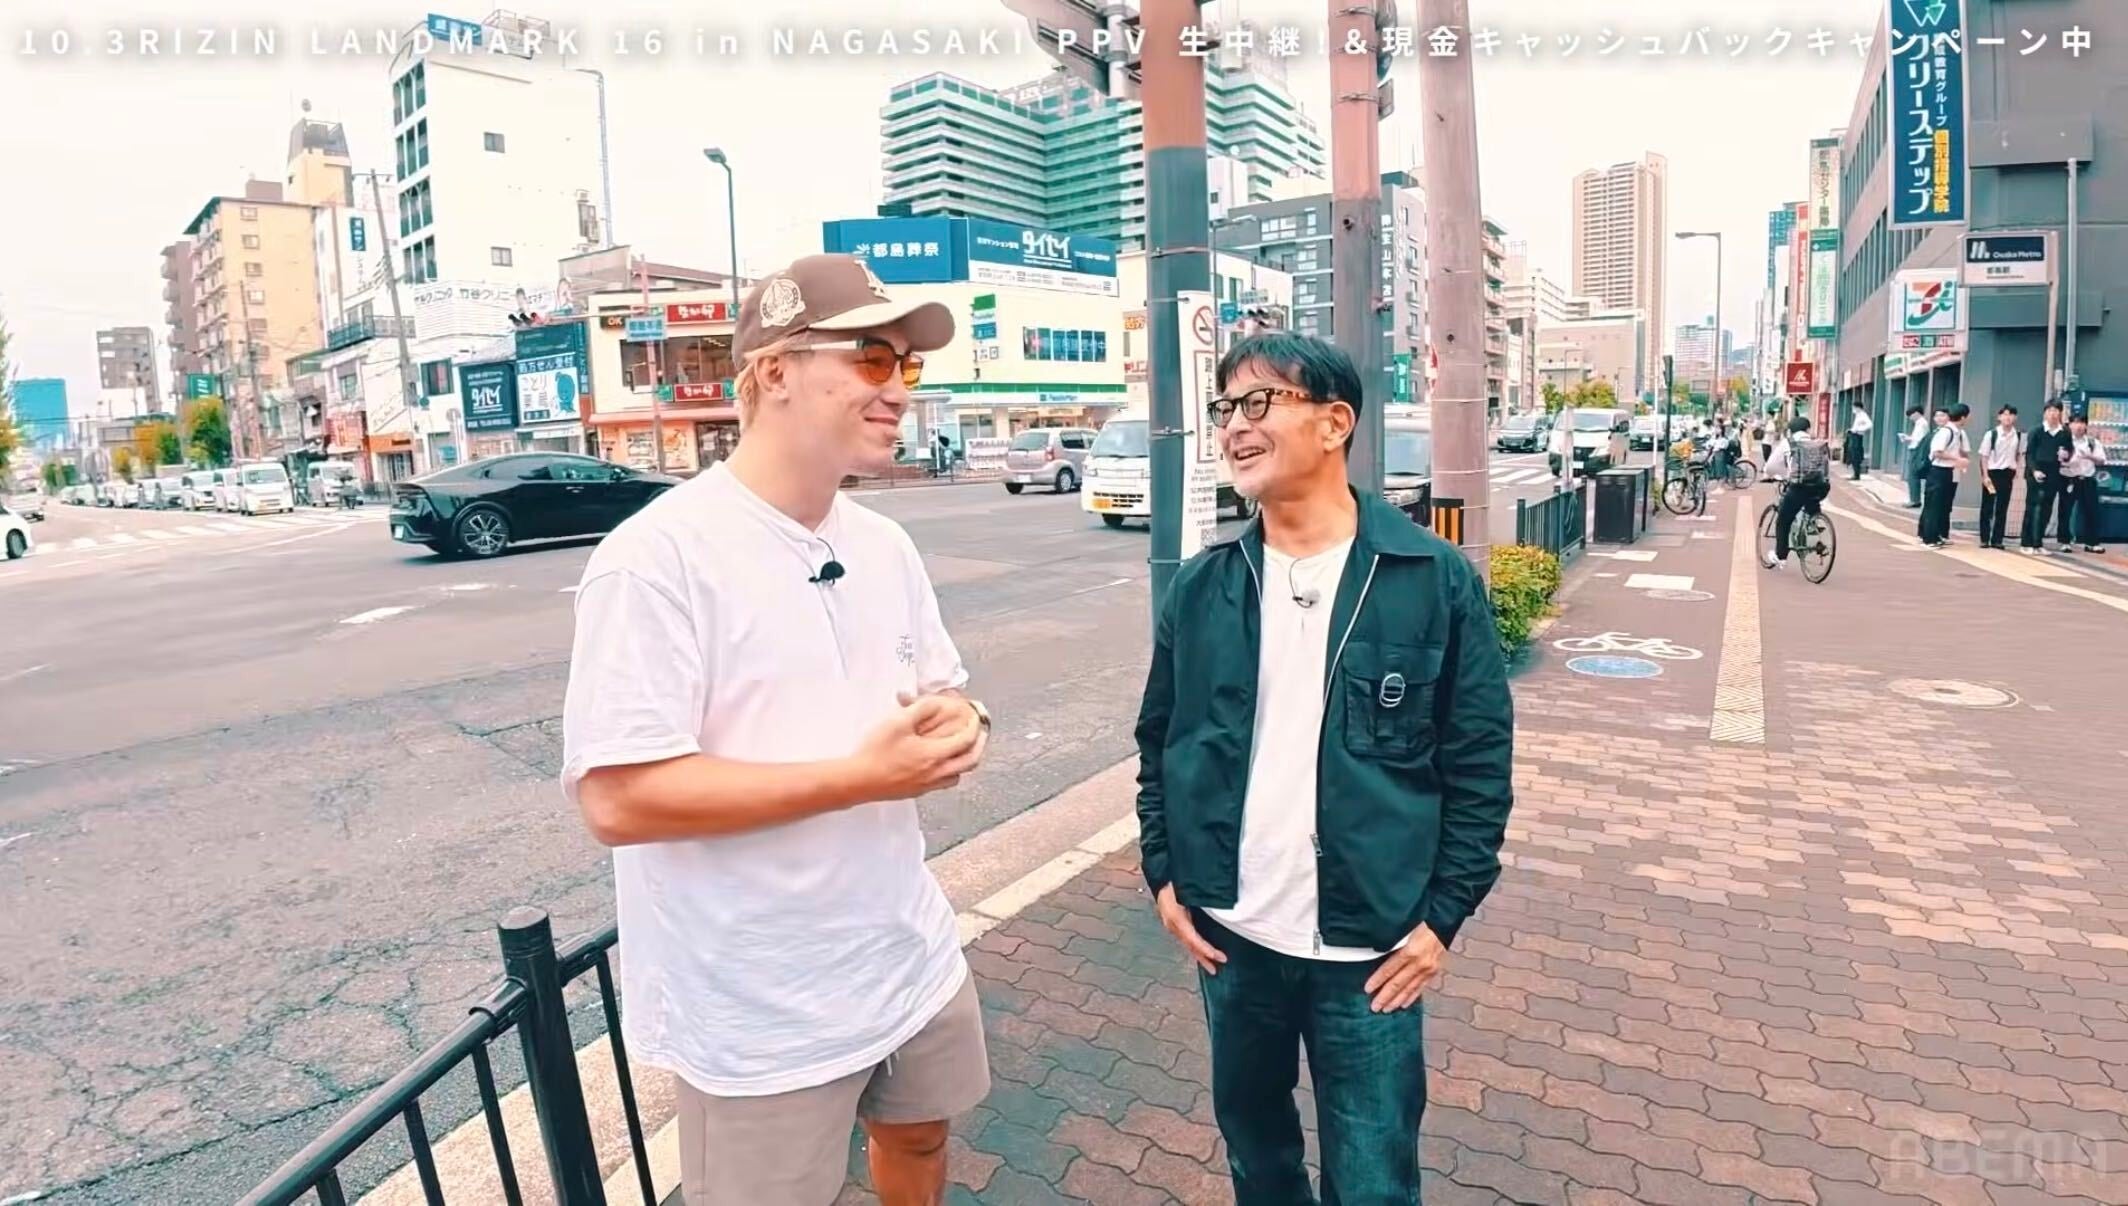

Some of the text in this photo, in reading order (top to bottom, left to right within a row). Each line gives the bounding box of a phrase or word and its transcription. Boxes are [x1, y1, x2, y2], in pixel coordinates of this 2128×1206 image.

[873, 242, 939, 257] 都島葬祭
[1022, 230, 1071, 259] タイセイ
[2018, 250, 2042, 258] Metro
[607, 316, 623, 326] OK
